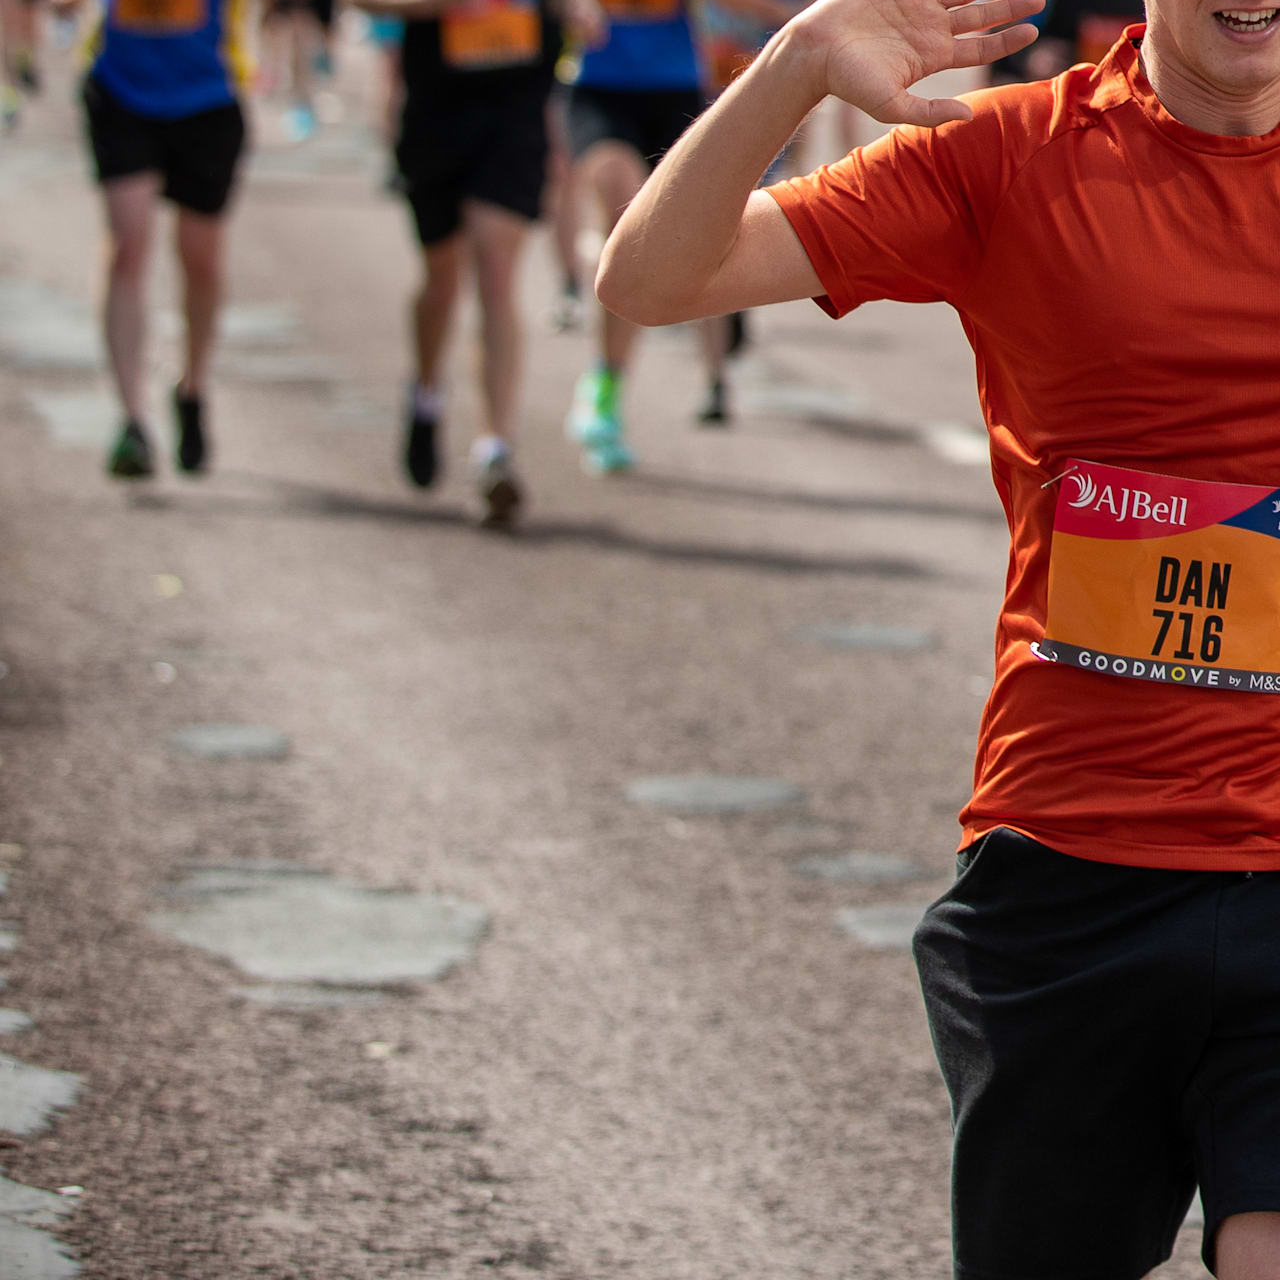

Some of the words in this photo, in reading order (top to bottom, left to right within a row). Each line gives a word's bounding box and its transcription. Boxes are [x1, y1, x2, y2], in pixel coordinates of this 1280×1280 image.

[1093, 485, 1188, 526] AJBell
[1155, 556, 1232, 610] DAN
[1150, 609, 1223, 663] 716
[1078, 651, 1220, 686] GOODMOVE
[1228, 675, 1241, 688] by
